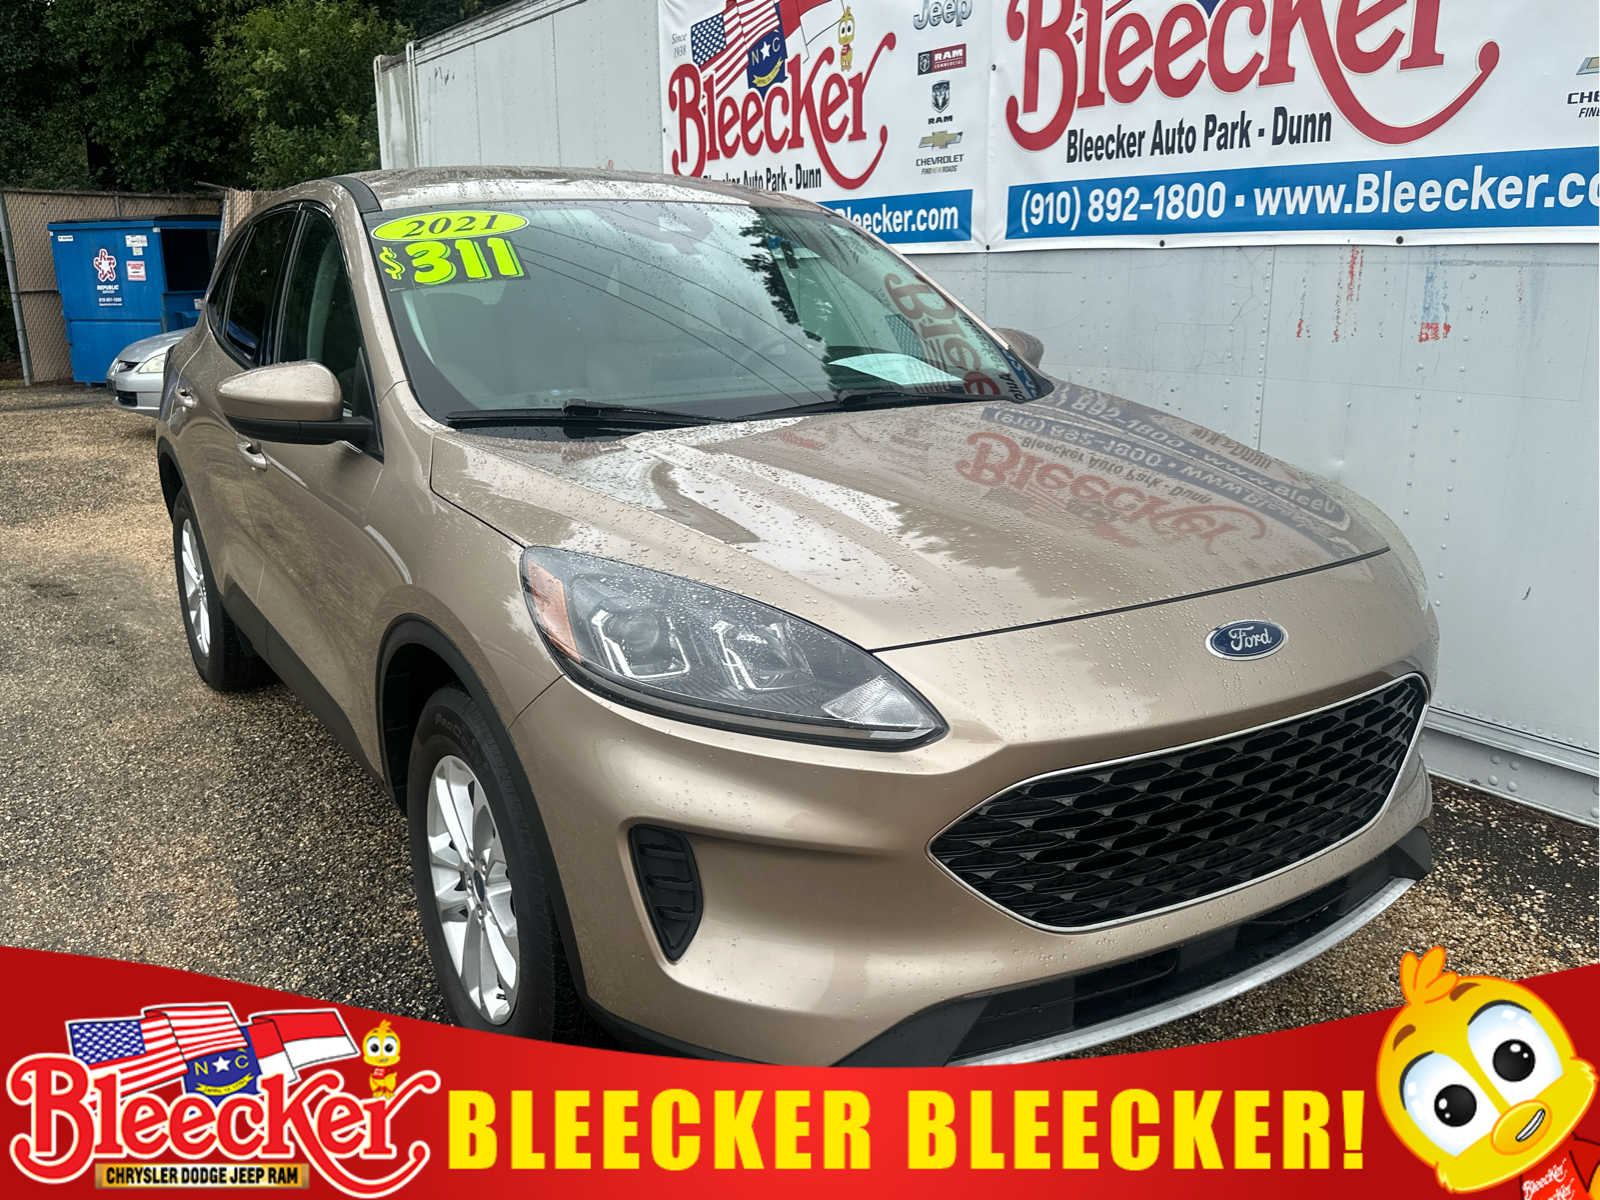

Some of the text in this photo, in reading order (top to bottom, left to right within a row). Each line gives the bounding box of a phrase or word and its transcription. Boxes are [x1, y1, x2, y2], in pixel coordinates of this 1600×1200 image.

[913, 0, 973, 30] Jeep
[934, 49, 963, 61] RAM
[1006, 0, 1500, 151] Bleecker
[668, 32, 896, 190] Bleecker
[928, 115, 953, 125] RAM
[1066, 124, 1145, 163] Bleecker
[1150, 118, 1197, 156] Auto
[1203, 110, 1252, 151] Park
[1271, 106, 1332, 146] Dunn
[915, 154, 964, 167] CHEVROLET
[766, 165, 788, 192] Park
[795, 163, 822, 189] Dunn
[1021, 186, 1080, 232] (910)
[1087, 181, 1226, 223] 892-1800
[402, 214, 499, 239] 2021
[379, 236, 525, 286] $311
[1228, 626, 1273, 651] Ford
